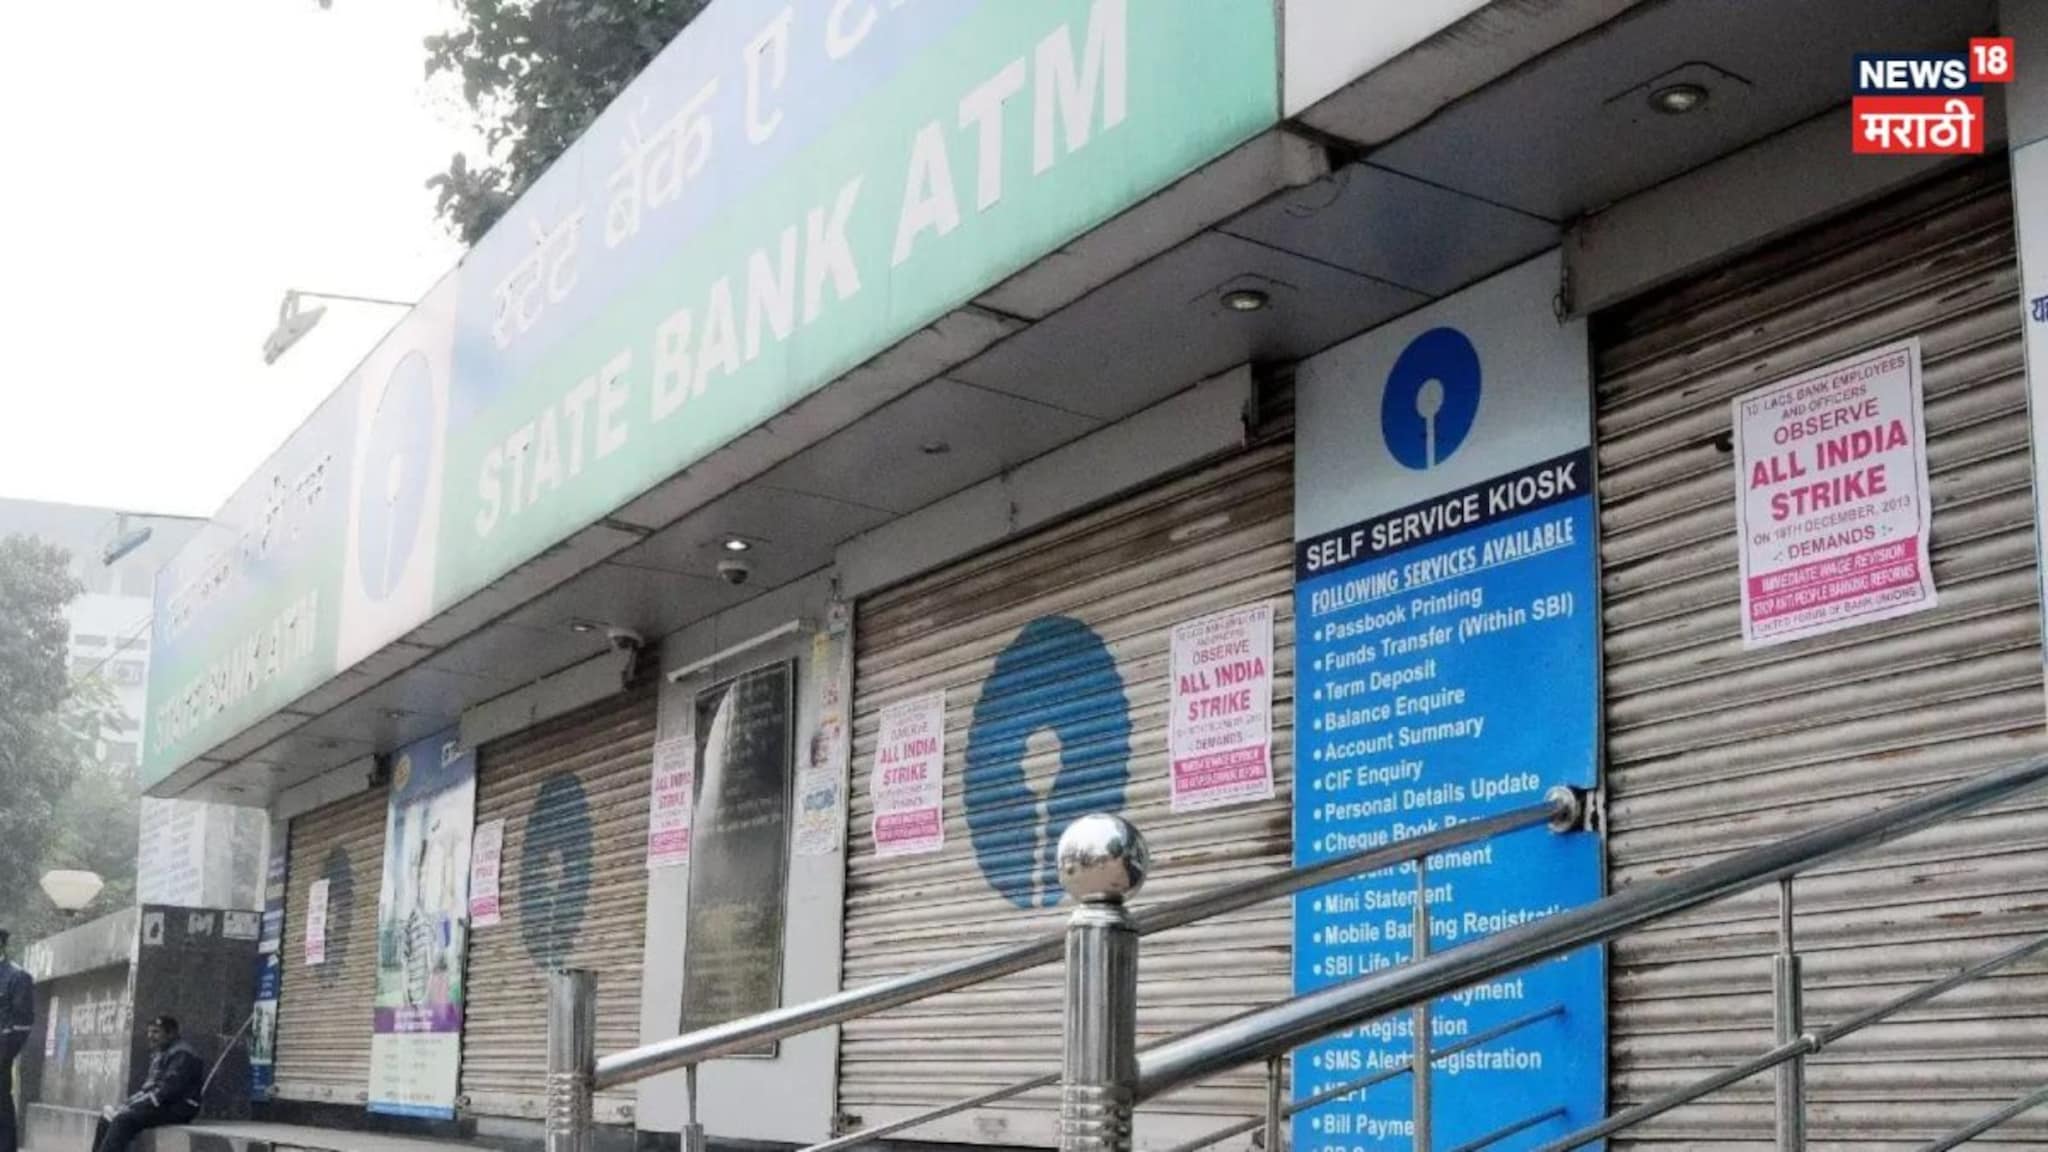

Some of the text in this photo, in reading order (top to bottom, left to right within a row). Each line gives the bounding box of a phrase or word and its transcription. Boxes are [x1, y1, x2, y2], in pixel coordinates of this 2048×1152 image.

[474, 0, 1128, 539] STATE BANK ATM
[1763, 391, 1793, 411] LACS
[1797, 381, 1830, 400] BANK
[1832, 355, 1906, 389] EMPLOYEES
[1782, 384, 1867, 419] AND OFFICERS
[1773, 397, 1880, 445] OBSERVE
[1751, 419, 1908, 490] ALL INDIA
[1770, 464, 1887, 521] STRIKE
[1306, 461, 1577, 571] SELF SERVICE KIOSK
[1753, 533, 1771, 547] ON
[1881, 496, 1911, 514] 2013
[1787, 525, 1876, 560] DEMANDS
[1854, 543, 1905, 569] REVISION
[1311, 516, 1574, 612] FOLLOWING SERVICES AVAILABLE
[1870, 563, 1915, 588] REFORMS
[1325, 586, 1483, 643] Passbook Printing
[1325, 592, 1573, 672] Funds Transfer (Within SBI)
[1192, 639, 1250, 666] OBSERVE
[1180, 656, 1265, 697] ALL INDIA
[1325, 659, 1437, 700] Term Deposit
[1188, 689, 1251, 721] STRIKE
[1325, 687, 1465, 732] Balance Enquire
[903, 737, 938, 758] INDIA
[1325, 716, 1485, 762] Account Summary
[883, 762, 928, 785] STRIKE
[1325, 759, 1424, 792] CIF Enquiry
[1325, 770, 1540, 820] Personal Details Update
[1325, 828, 1388, 853] Cheque
[1325, 894, 1360, 914] Mini
[1325, 919, 1380, 945] Mobile
[1385, 917, 1457, 942] Baning
[1325, 955, 1353, 977] SBI
[1324, 1050, 1361, 1070] SMS
[1323, 1113, 1415, 1141] Bill Payme
